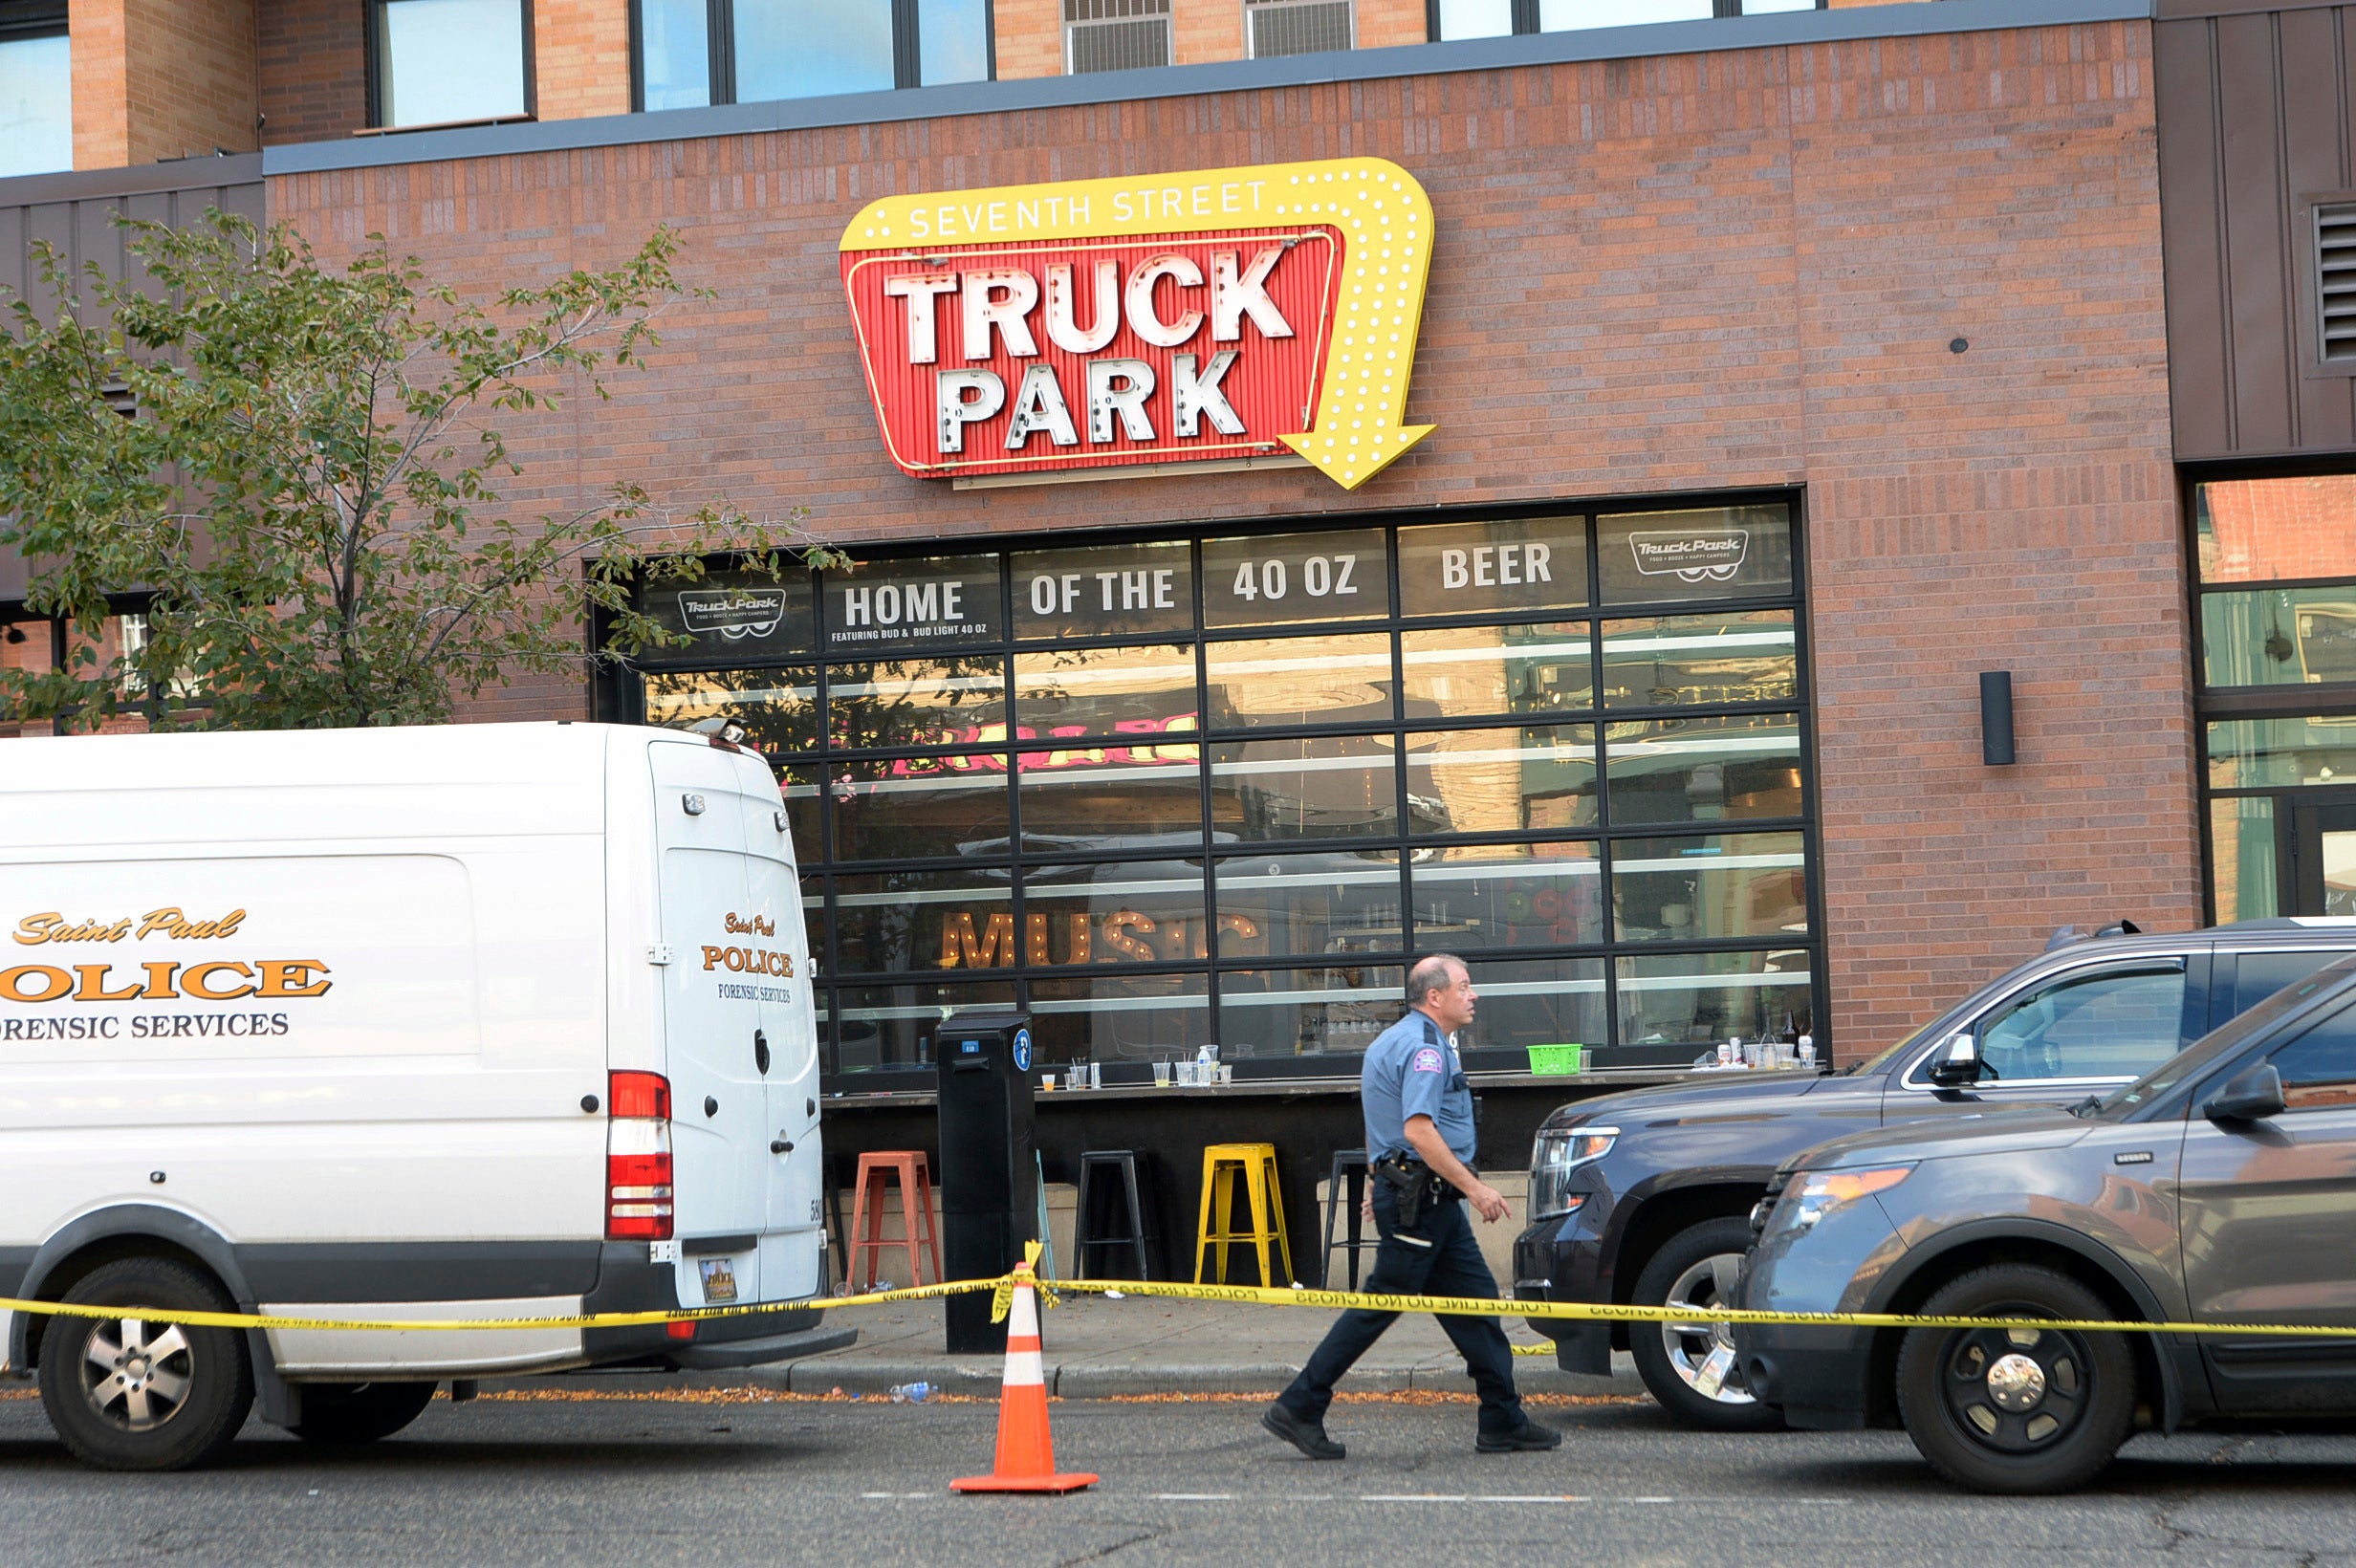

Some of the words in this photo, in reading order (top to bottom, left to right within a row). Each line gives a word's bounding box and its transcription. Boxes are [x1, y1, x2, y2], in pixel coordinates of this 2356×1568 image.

[909, 196, 1091, 238] SEVENTH
[1113, 180, 1267, 221] STREET
[884, 246, 1297, 365] TRUCK
[935, 350, 1248, 454] PARK
[845, 580, 964, 626] HOME
[1030, 574, 1081, 616] OF
[1095, 569, 1175, 611] THE
[1233, 557, 1287, 602] 40
[1304, 554, 1359, 598] OZ
[1442, 542, 1552, 590] BEER
[831, 629, 879, 642] FEATURING
[881, 628, 900, 640] BUD
[901, 628, 909, 638] &
[913, 627, 931, 638] BUD
[933, 625, 958, 636] LIGHT
[961, 624, 973, 635] 40
[975, 623, 987, 633] OZ
[12, 911, 133, 946] Saint
[136, 906, 247, 941] Paul
[724, 911, 753, 936] Saint
[942, 909, 1260, 974] MUSIC
[701, 945, 795, 979] POLICE
[718, 983, 759, 1001] FORENSIC
[759, 987, 791, 1005] SERVICES
[0, 1015, 120, 1041] RENSIC
[131, 1013, 289, 1039] SERVICES
